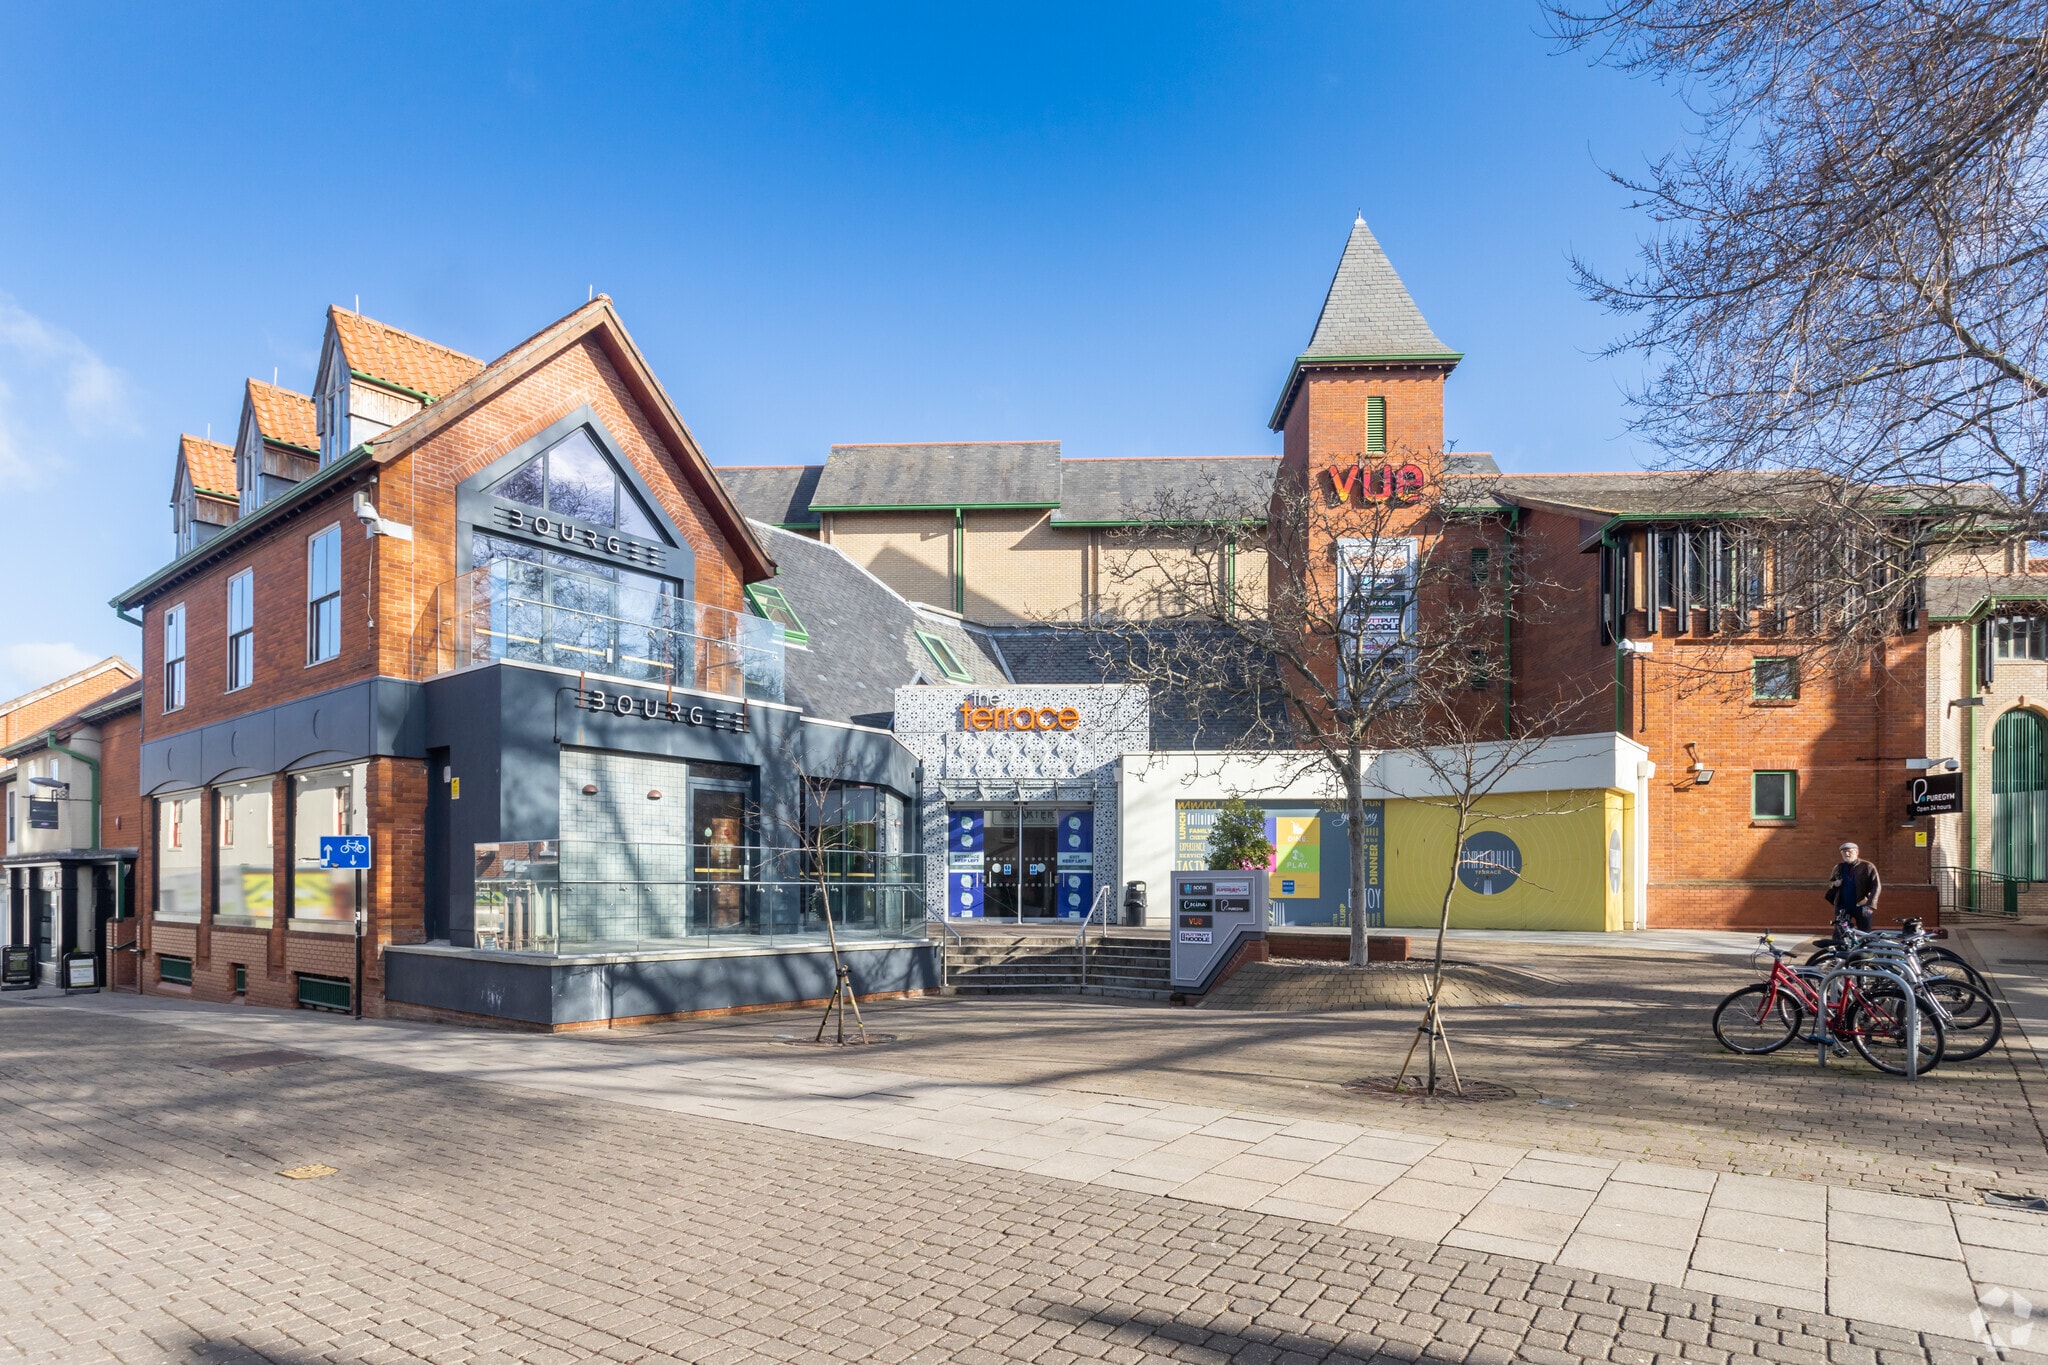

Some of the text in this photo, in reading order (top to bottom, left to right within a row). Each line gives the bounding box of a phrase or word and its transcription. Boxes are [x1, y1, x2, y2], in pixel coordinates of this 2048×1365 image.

[972, 690, 1000, 706] the
[960, 701, 1080, 731] terrace
[1926, 793, 1955, 802] PUREGYM
[1176, 860, 1206, 871] TASTY
[1369, 844, 1379, 885] DINNER
[1462, 850, 1516, 869] TIMBERHILL
[1184, 900, 1208, 910] Cocina
[1348, 887, 1381, 909] EJOY
